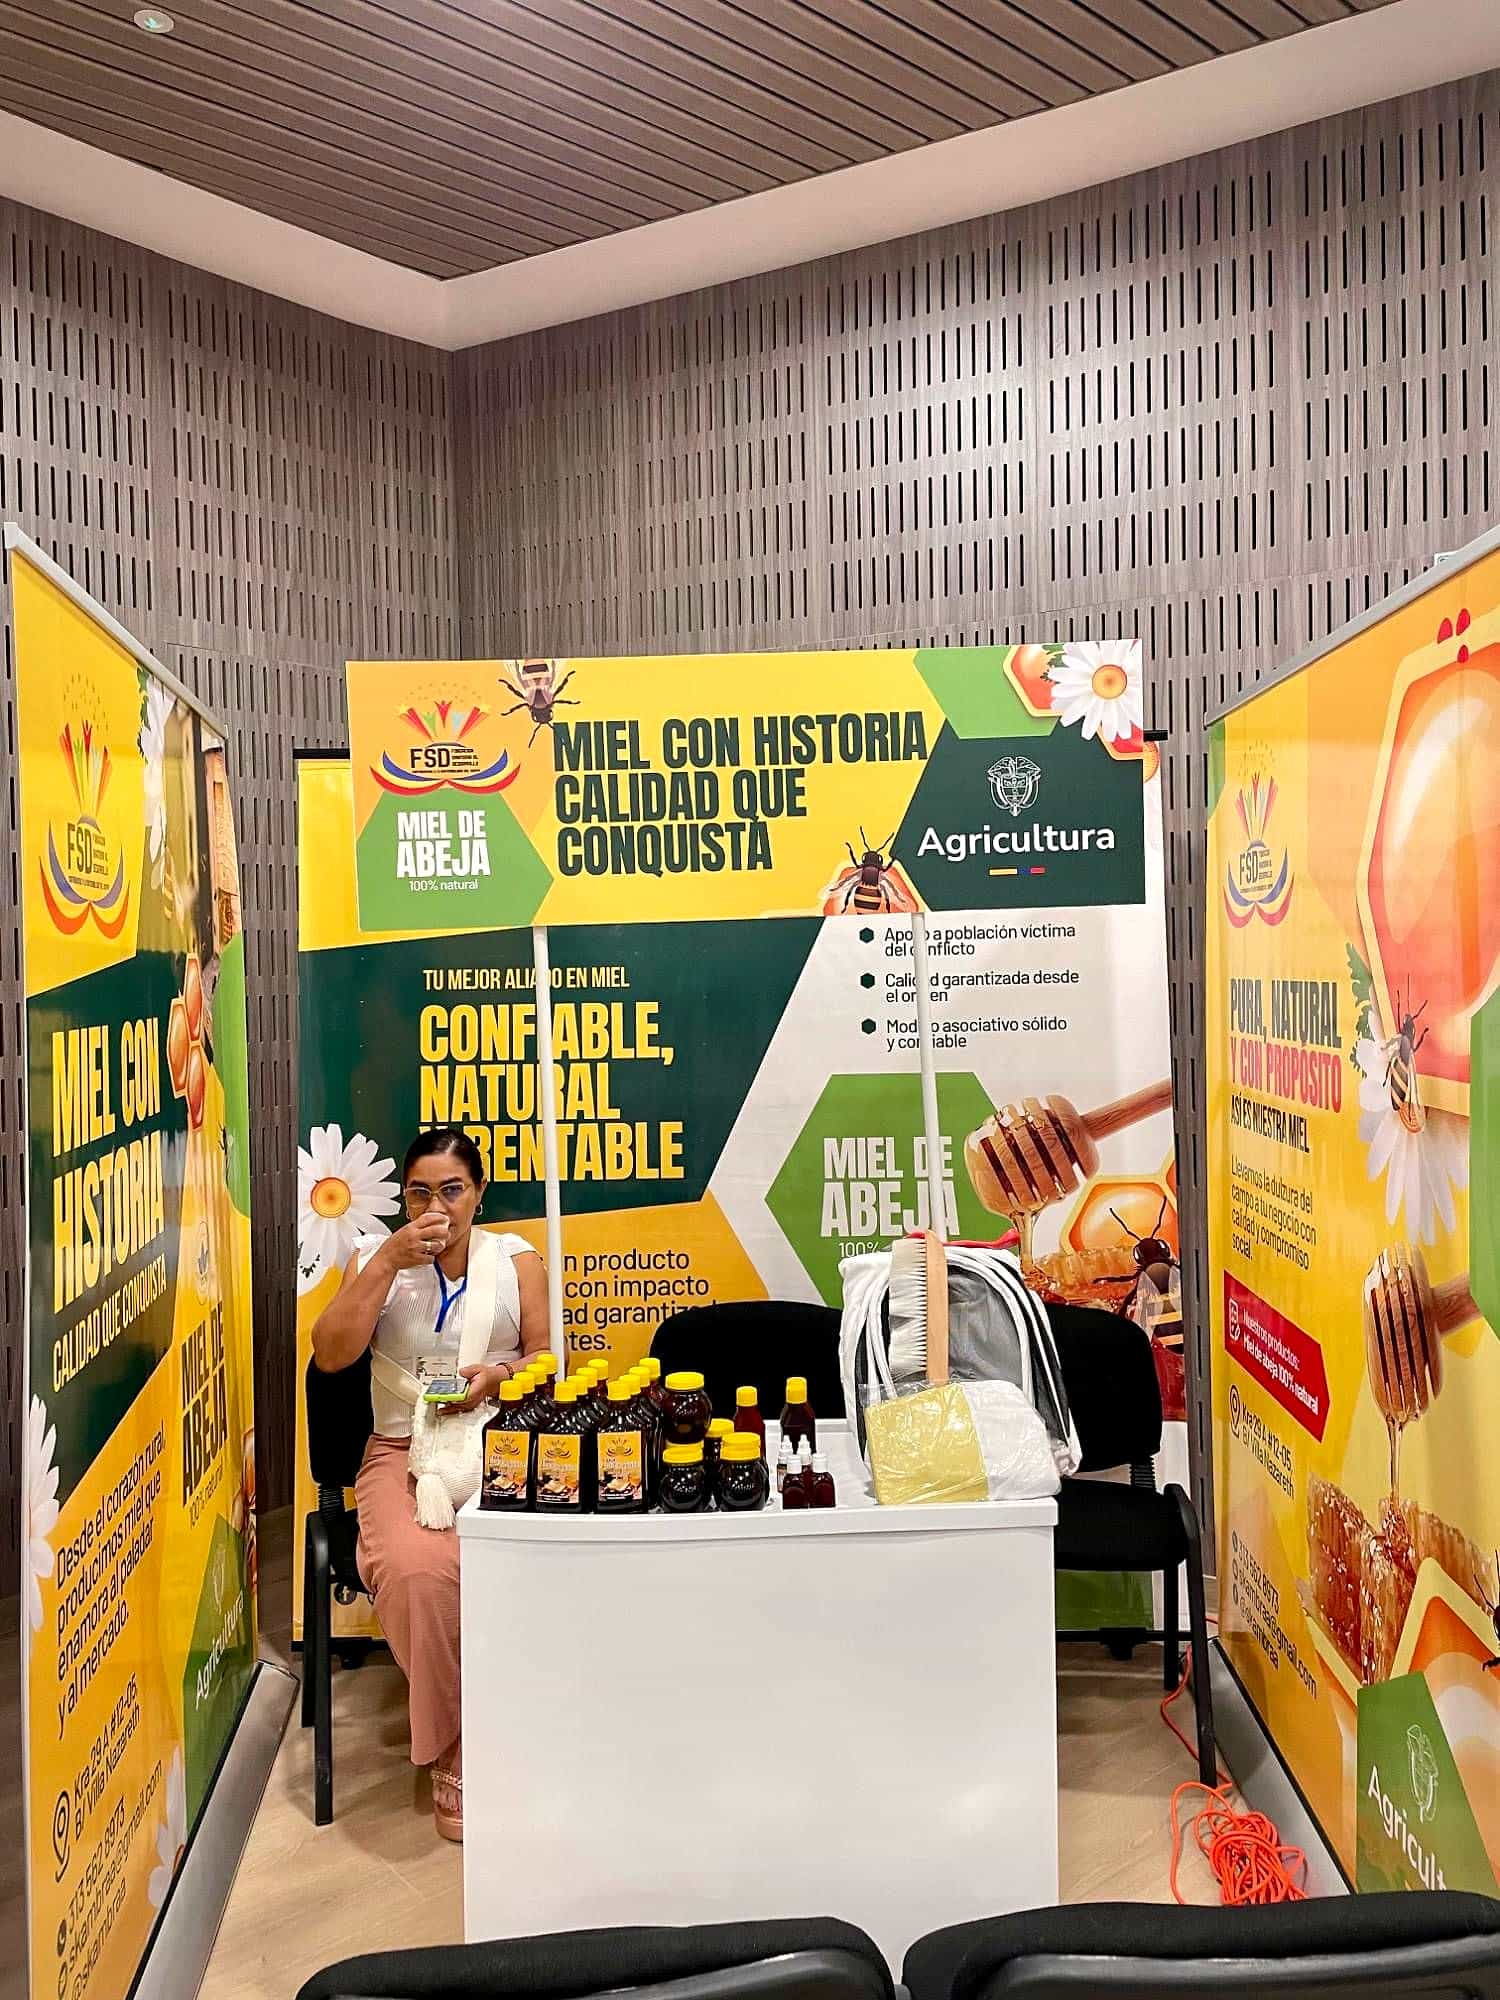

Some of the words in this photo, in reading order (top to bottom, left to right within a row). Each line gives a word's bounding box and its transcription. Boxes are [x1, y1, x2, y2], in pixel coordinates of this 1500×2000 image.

[410, 747, 450, 768] FSD
[553, 720, 650, 772] MIEL
[662, 717, 740, 768] CON
[753, 710, 928, 766] HISTORIA
[397, 811, 453, 839] MIEL
[458, 810, 487, 839] DE
[555, 770, 720, 824] CALIDAD
[732, 767, 807, 823] QUE
[67, 823, 93, 874] FSD
[396, 839, 491, 878] ABEJA
[557, 821, 773, 877] CONQUISTA
[917, 823, 1115, 862] Agricultura
[1239, 849, 1259, 885] FSD
[409, 879, 439, 892] 100%
[440, 879, 479, 891] natural
[885, 942, 906, 957] del
[910, 941, 975, 956] nflicto
[933, 930, 942, 941] a
[945, 924, 1017, 946] población
[1021, 923, 1076, 938] víctima
[423, 969, 443, 990] TU
[448, 968, 501, 990] MEJOR
[505, 967, 562, 990] ALIAO
[566, 967, 587, 989] EN
[592, 967, 630, 988] MIEL
[885, 973, 939, 988] Calid
[942, 971, 1030, 990] garantizada
[1033, 969, 1080, 985] desde
[886, 988, 899, 1003] el
[901, 990, 949, 1003] oren
[419, 1001, 675, 1066] CONFABLE,
[887, 1019, 940, 1034] Modo
[942, 1017, 1019, 1032] asociativo
[1022, 1016, 1068, 1030] sólido
[887, 1037, 895, 1053] y
[898, 1034, 968, 1050] coiable
[1230, 978, 1268, 1044] PURA,
[1271, 979, 1342, 1049] NATURAL
[52, 1024, 115, 1158] MIEL
[121, 1016, 161, 1128] CON
[1230, 1036, 1237, 1084] Y
[1240, 1038, 1263, 1091] CON
[1266, 1042, 1342, 1114] PROPÓSITO
[1231, 1093, 1242, 1128] ASÍ
[1243, 1099, 1253, 1131] ES
[1253, 1102, 1288, 1145] NUESTRA
[1288, 1113, 1310, 1153] MIEL
[823, 1136, 904, 1179] MIEL
[913, 1136, 954, 1178] DE
[1231, 1153, 1263, 1190] Llevamos
[1263, 1168, 1270, 1193] la
[1270, 1175, 1299, 1208] dulzura
[1300, 1187, 1313, 1215] del
[53, 1130, 164, 1314] HISTORIA
[820, 1180, 961, 1238] ABEJA
[1231, 1183, 1254, 1214] campo
[1260, 1195, 1268, 1218] tu
[1268, 1204, 1300, 1232] negocio
[1300, 1221, 1317, 1246] con
[1231, 1207, 1255, 1237] calidad
[1260, 1226, 1310, 1271] compromiso
[583, 1247, 690, 1277] producto
[1232, 1232, 1253, 1261] social.
[564, 1280, 609, 1299] con
[614, 1274, 709, 1302] impacto
[53, 1308, 100, 1393] CALIDAD
[102, 1288, 121, 1348] QUE
[122, 1254, 167, 1329] CONQUISTA
[181, 1319, 210, 1411] MIEL
[211, 1300, 225, 1375] DE
[182, 1363, 229, 1509] ABEJA
[57, 1517, 94, 1590] Desde
[95, 1495, 105, 1537] el
[106, 1453, 144, 1522] corazón
[57, 1523, 124, 1646] producimos
[124, 1484, 144, 1541] miel
[145, 1469, 161, 1515] que
[58, 1586, 109, 1681] enamora
[110, 1559, 119, 1603] al
[120, 1515, 154, 1596] paladar
[58, 1694, 67, 1741] y
[67, 1666, 78, 1715] al
[80, 1598, 130, 1695] mercado.
[194, 1588, 246, 1711] Agricultura
[73, 1765, 90, 1807] Kra
[90, 1735, 102, 1777] 29
[102, 1723, 110, 1755] A
[74, 1796, 86, 1842] B/
[86, 1769, 105, 1816] Villa
[105, 1701, 140, 1783] Nazareth
[1367, 1764, 1447, 1891] Agricult
[68, 1877, 86, 1933] 313
[86, 1842, 104, 1895] 562
[103, 1795, 126, 1859] 8973
